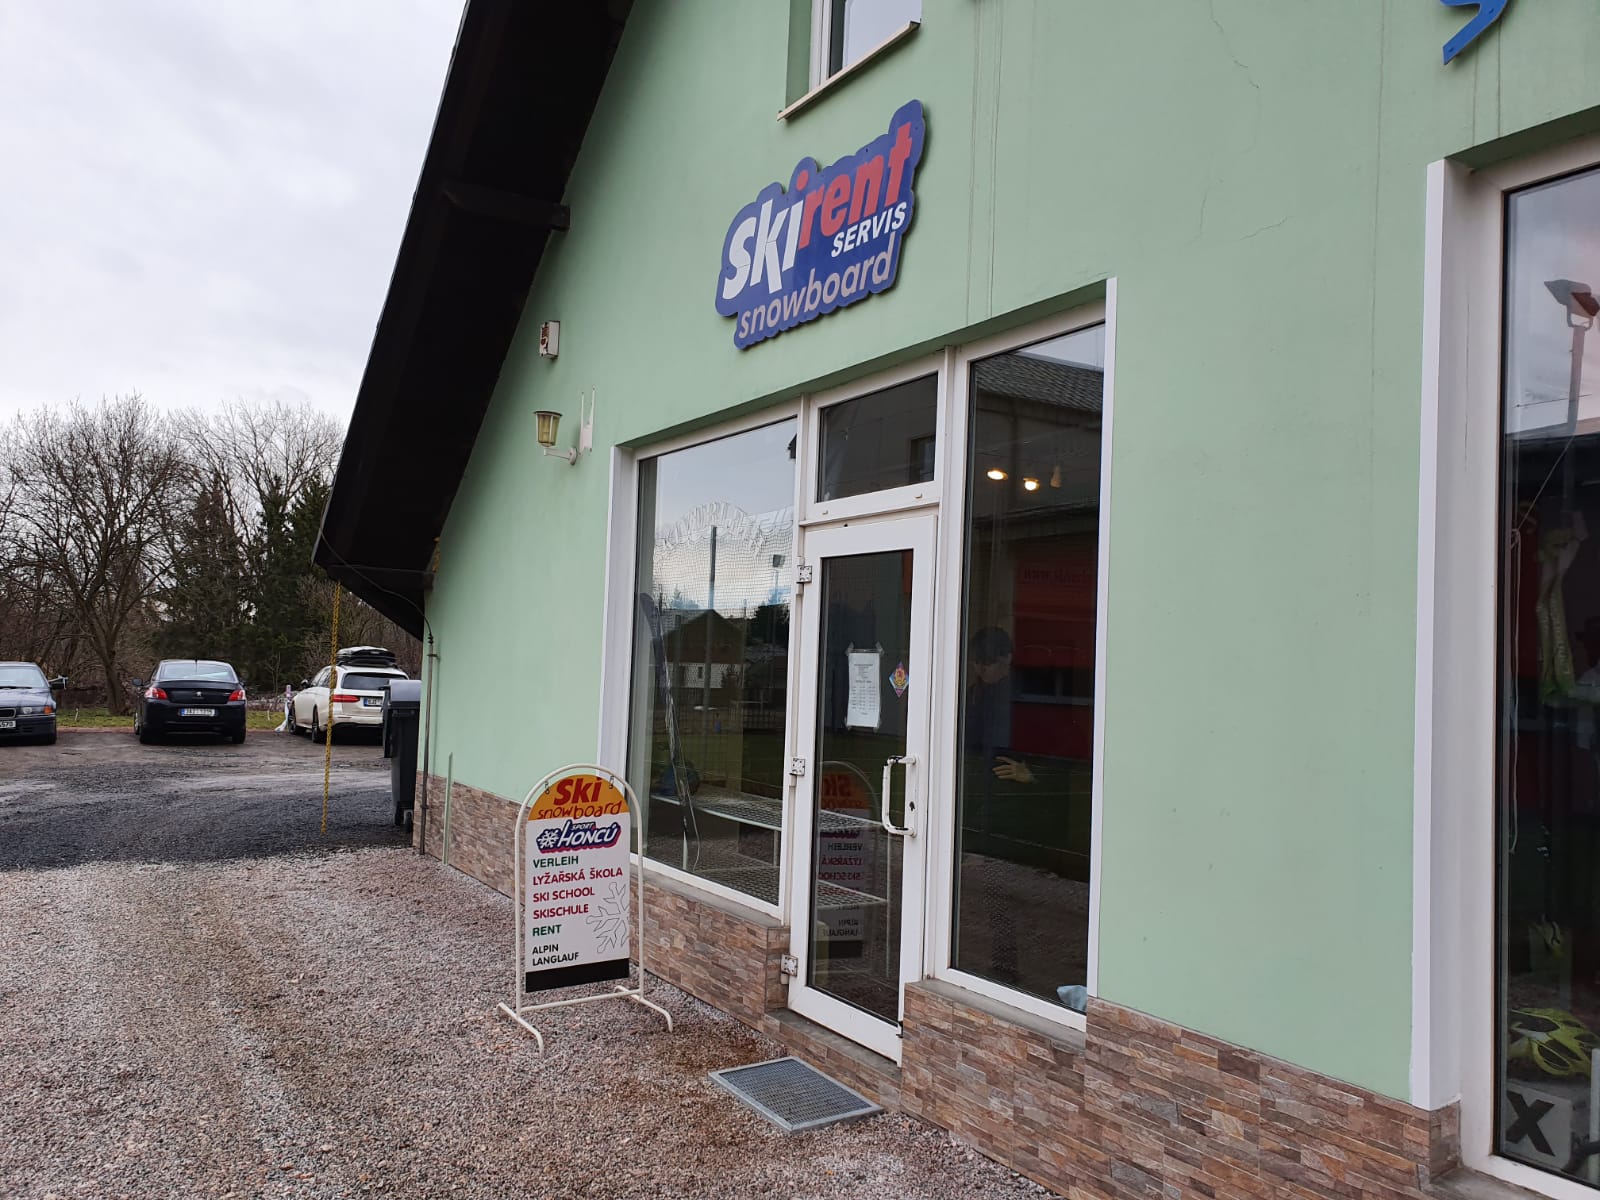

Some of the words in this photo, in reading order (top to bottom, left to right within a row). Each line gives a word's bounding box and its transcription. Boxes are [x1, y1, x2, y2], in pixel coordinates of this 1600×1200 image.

[831, 201, 907, 258] SERVIS
[738, 231, 896, 339] snowboard
[537, 800, 622, 820] snowboard
[533, 856, 579, 868] VERLEIH
[533, 869, 585, 886] LYŽAŘSKÁ
[589, 867, 623, 880] ŠKOLA
[533, 891, 550, 902] SKI
[552, 887, 595, 901] SCHOOL
[533, 904, 589, 919] SKISCHULE
[532, 924, 562, 937] RENT
[532, 943, 559, 955] ALPIN
[532, 952, 579, 966] LANGLAUF
